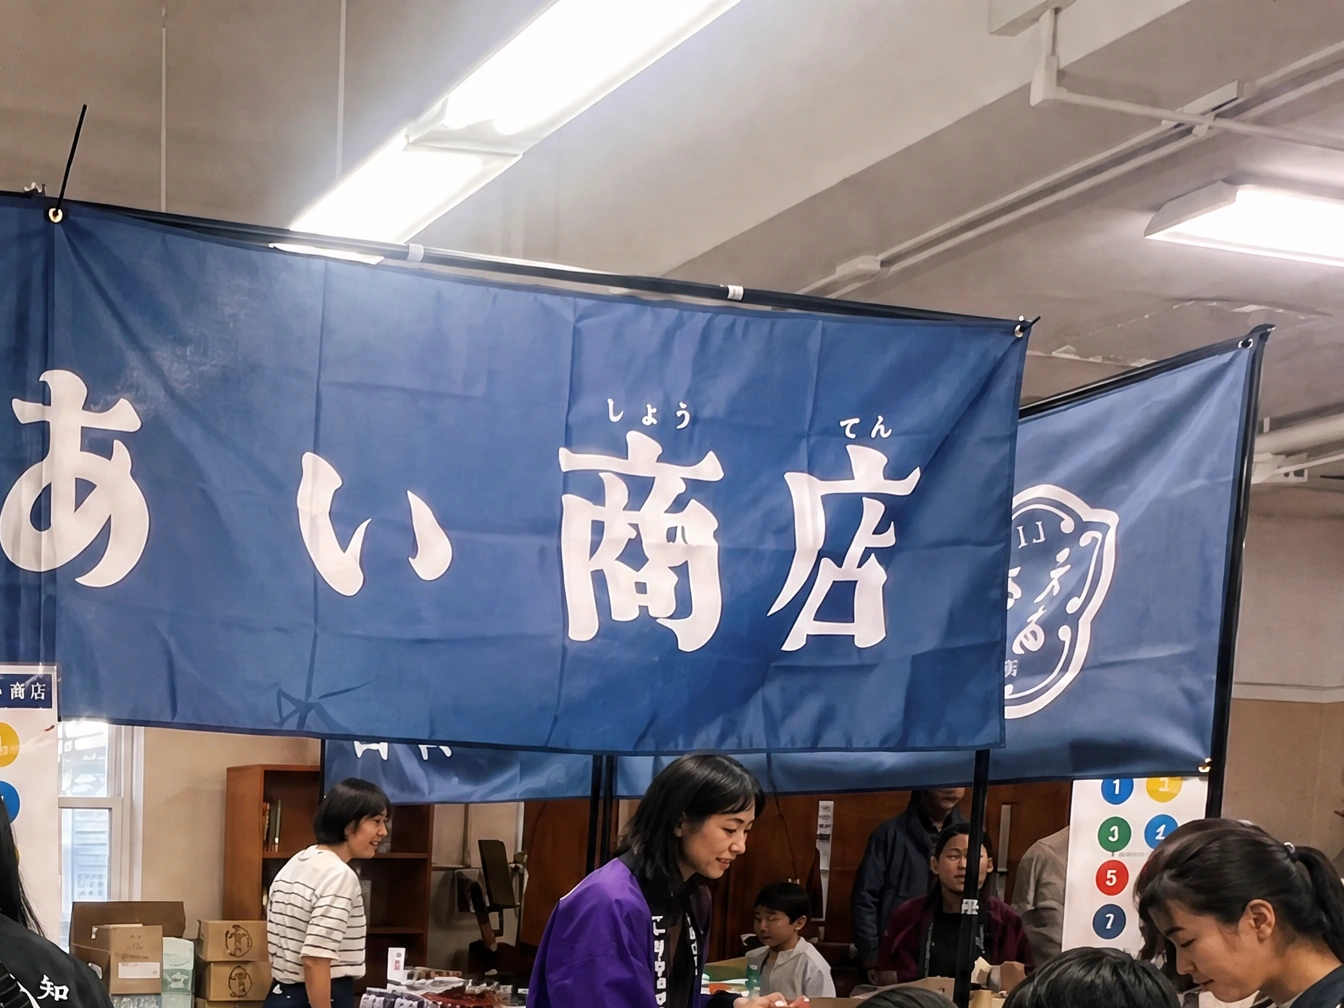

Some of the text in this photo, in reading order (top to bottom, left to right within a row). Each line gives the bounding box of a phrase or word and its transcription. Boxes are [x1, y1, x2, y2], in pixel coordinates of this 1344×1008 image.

[607, 398, 692, 430] しょう
[838, 415, 893, 440] てん
[1105, 869, 1117, 886] 5
[37, 974, 69, 1002] 知
